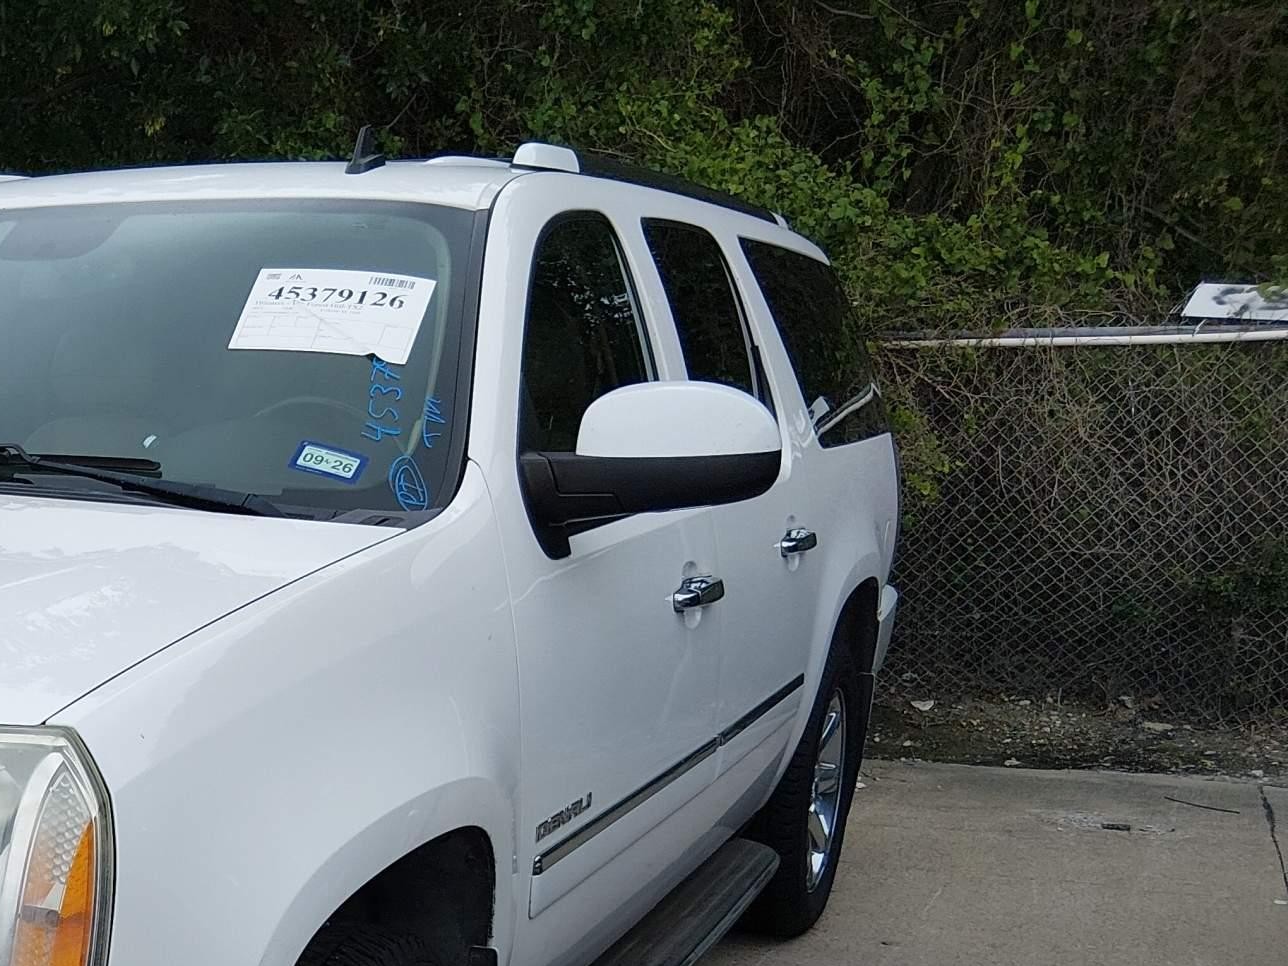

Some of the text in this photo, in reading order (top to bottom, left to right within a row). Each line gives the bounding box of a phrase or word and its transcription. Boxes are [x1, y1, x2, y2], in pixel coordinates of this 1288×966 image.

[267, 285, 409, 310] 45379126
[302, 452, 325, 465] 09
[330, 459, 354, 473] 26
[535, 791, 593, 843] DENALI
